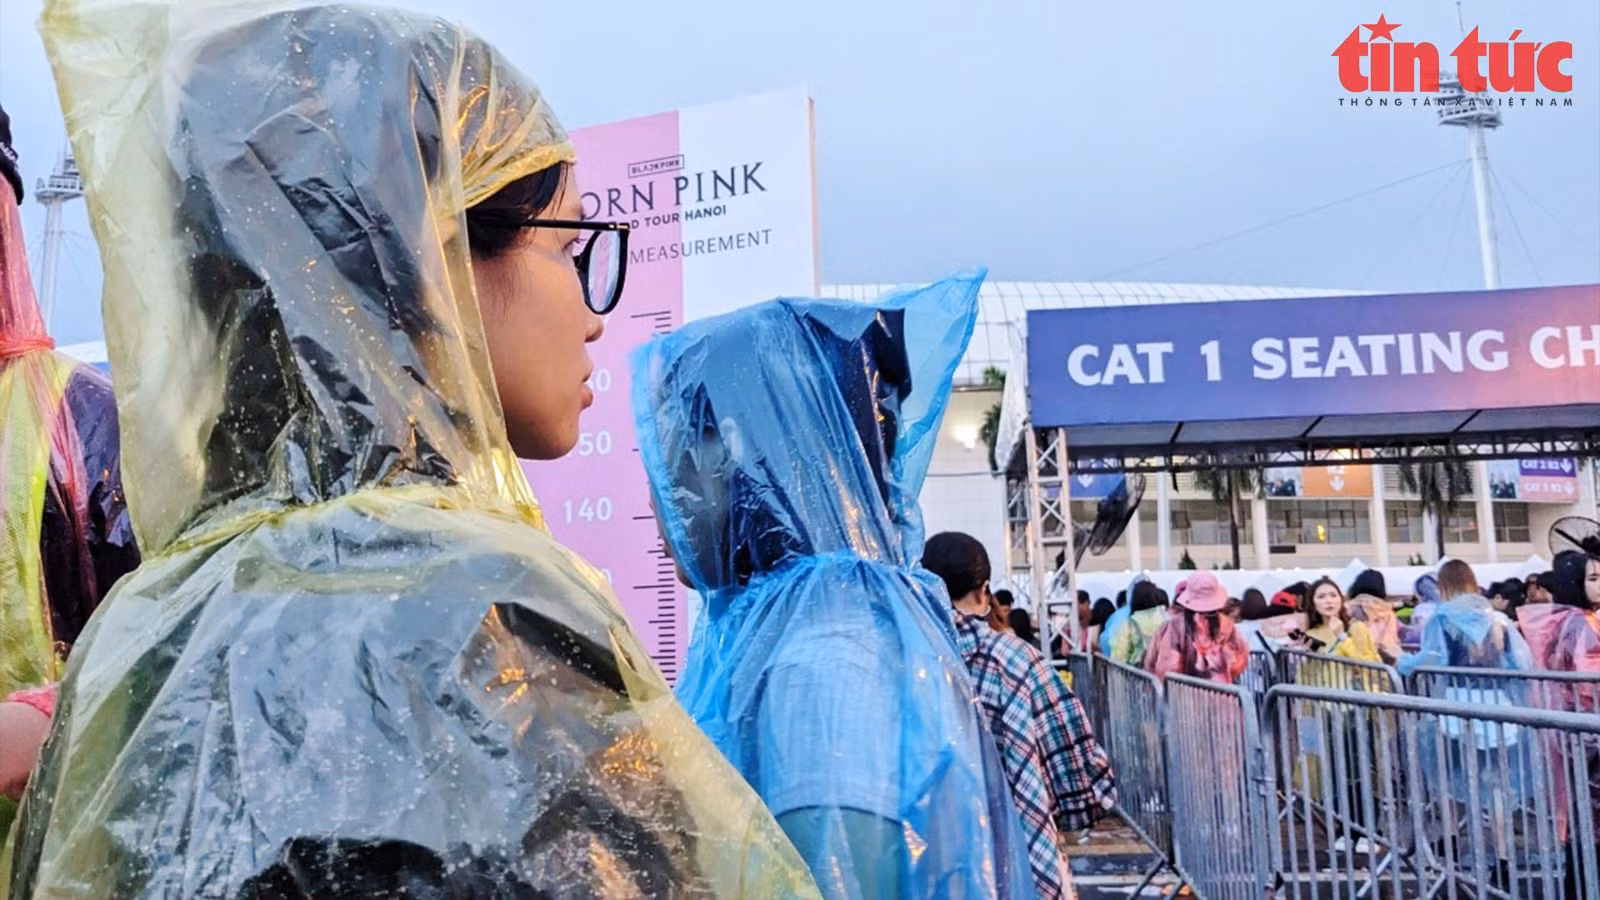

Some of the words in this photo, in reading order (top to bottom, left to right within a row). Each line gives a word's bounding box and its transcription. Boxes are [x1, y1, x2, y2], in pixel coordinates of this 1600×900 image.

[580, 181, 654, 220] ORN
[673, 162, 766, 206] PINK
[644, 213, 680, 227] TOUR
[684, 204, 726, 221] HANOI
[630, 228, 773, 264] MEASUREMENT
[1067, 342, 1173, 386] CAT
[1200, 340, 1222, 381] 1
[1251, 330, 1509, 380] SEATING
[1530, 324, 1600, 369] CH
[579, 431, 612, 456] 50
[564, 497, 612, 523] 140
